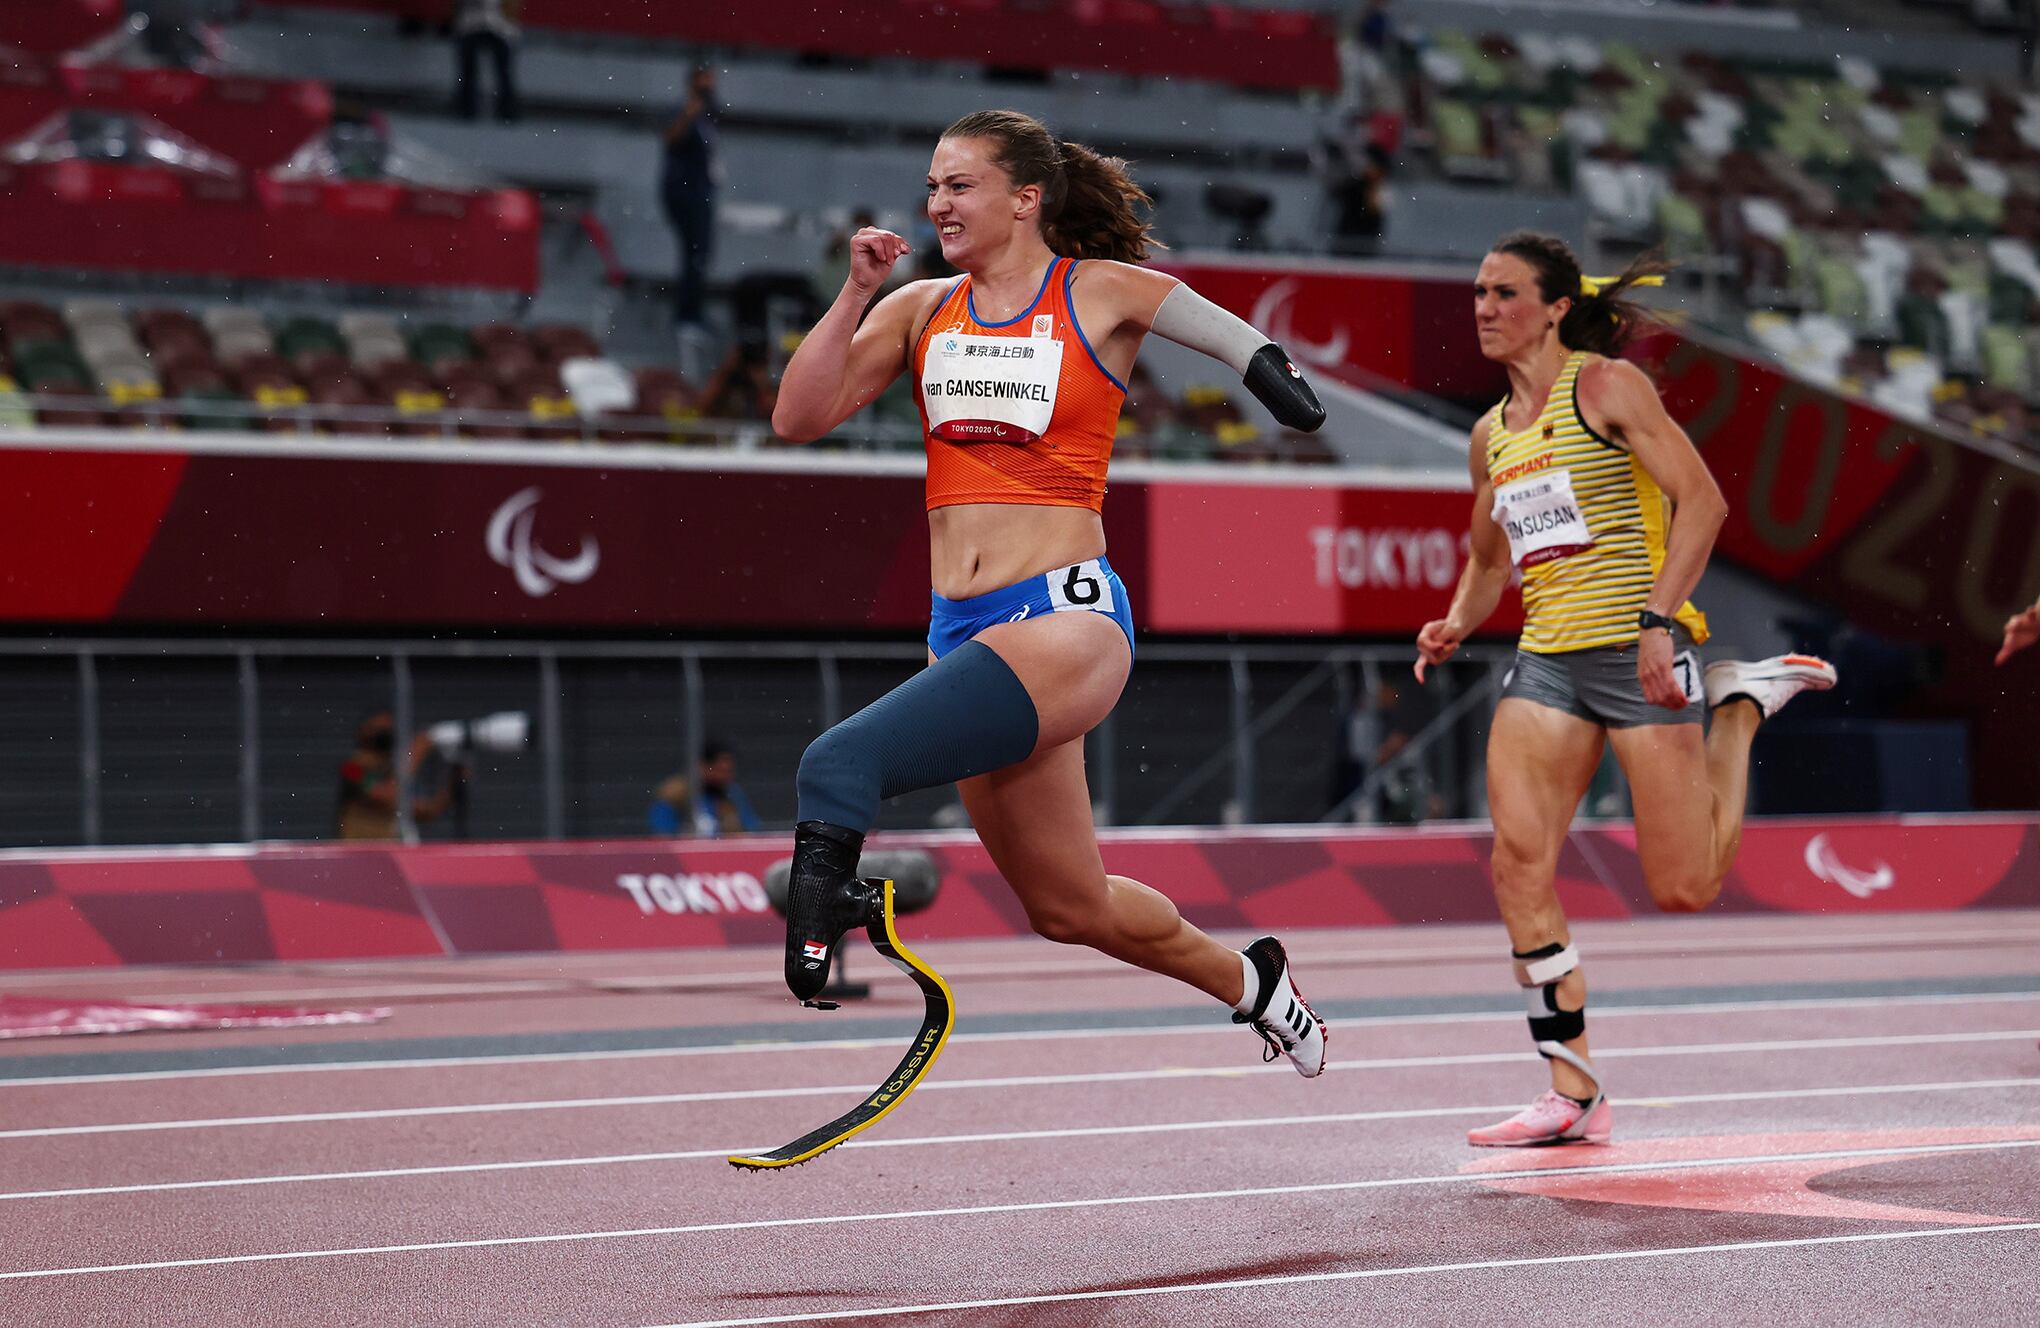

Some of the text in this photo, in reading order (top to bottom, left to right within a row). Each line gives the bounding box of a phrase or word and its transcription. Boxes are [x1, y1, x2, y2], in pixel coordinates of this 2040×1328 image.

[964, 344, 1035, 359] 東京海上日動
[925, 379, 1050, 402] van GANSEWINKEL
[951, 424, 992, 433] TOKYO 2020
[1308, 527, 1457, 589] TOKYO
[1063, 565, 1101, 605] 6
[616, 872, 770, 915] TOKYO
